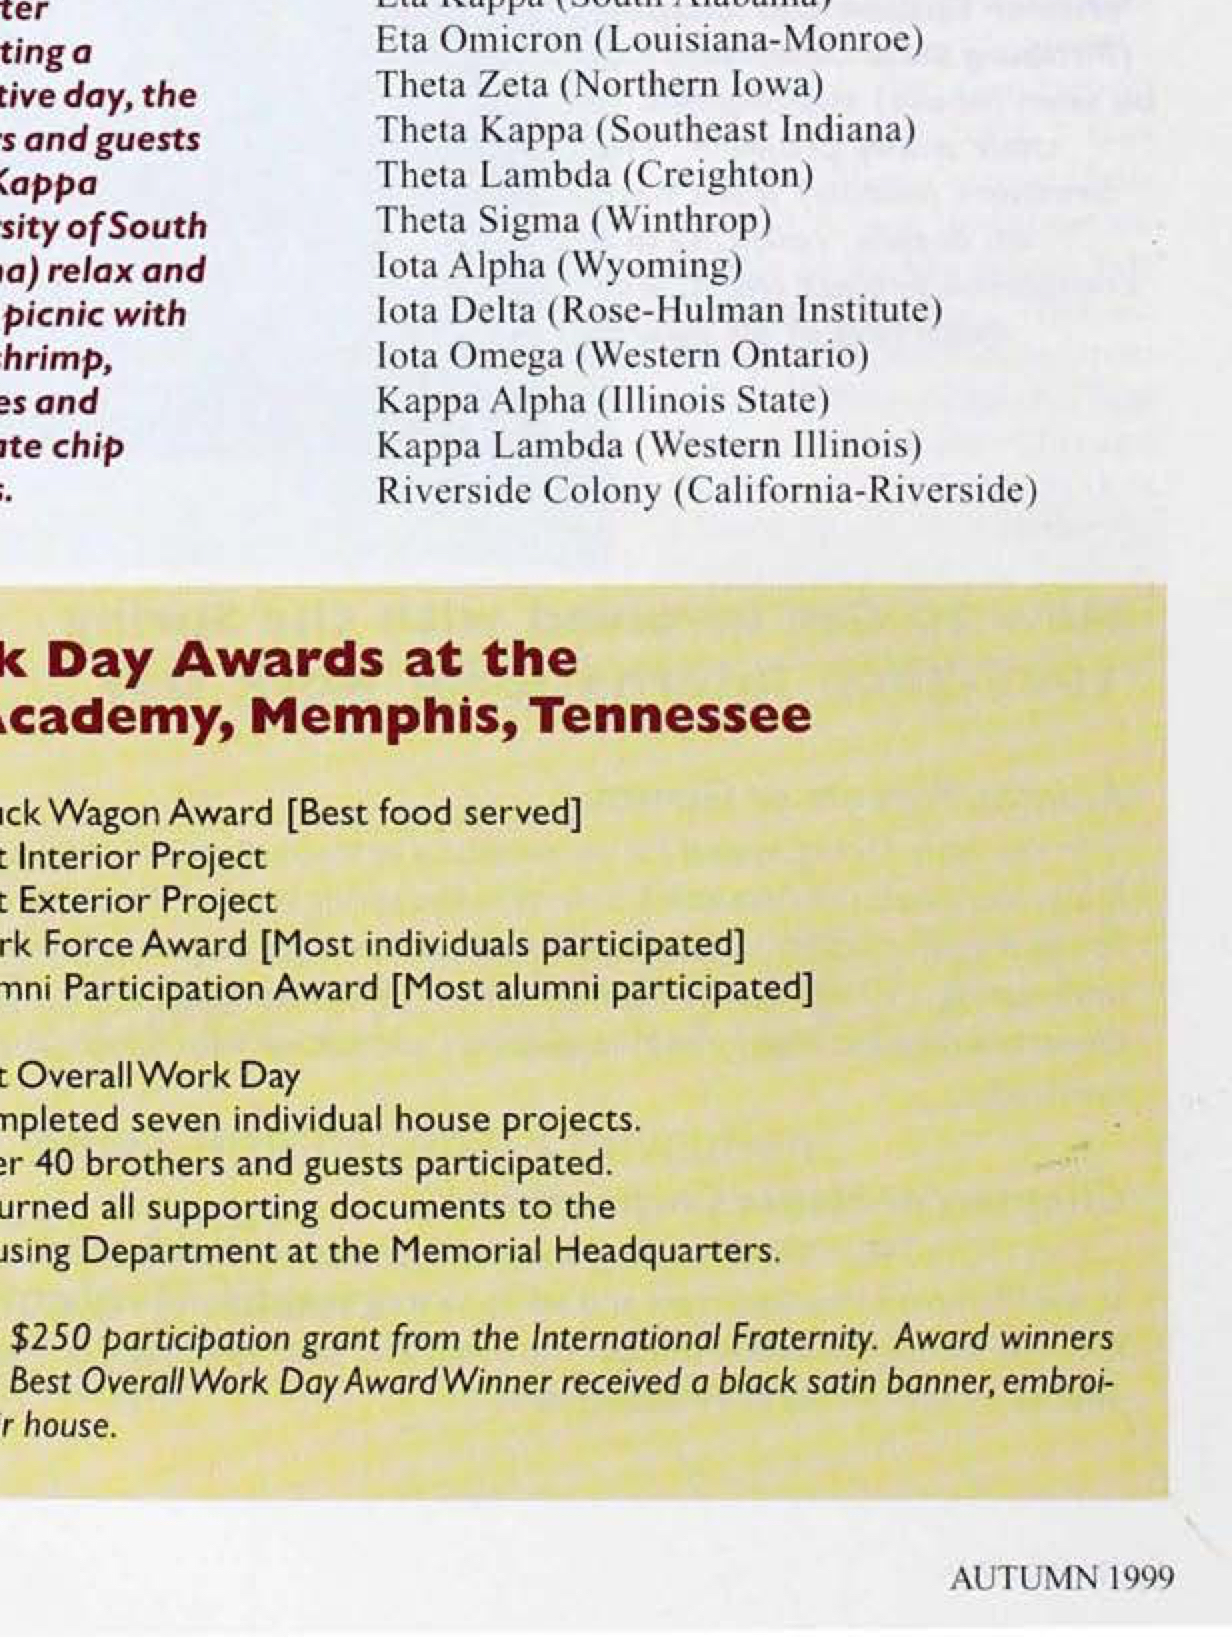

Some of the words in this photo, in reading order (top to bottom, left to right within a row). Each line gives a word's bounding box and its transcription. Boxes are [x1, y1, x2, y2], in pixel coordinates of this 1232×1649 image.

[71, 44, 93, 64] a
[377, 24, 428, 54] Eta
[440, 24, 582, 53] Omicron
[595, 24, 923, 56] (Louisiana-Monroe)
[63, 79, 133, 118] day,
[141, 79, 197, 108] the
[23, 122, 89, 152] and
[94, 128, 201, 161] guests
[67, 210, 108, 248] of
[108, 210, 207, 240] South
[378, 386, 479, 422] Kappa
[491, 384, 586, 422] Alpha
[597, 384, 725, 418] (Illinois
[737, 384, 829, 416] State)
[378, 474, 531, 504] Riverside
[543, 474, 661, 512] Colony
[674, 474, 1037, 507] (California-Riverside)
[47, 640, 155, 690] Day
[171, 639, 385, 678] Awards
[405, 639, 463, 678] at
[481, 638, 577, 678] the
[251, 694, 518, 746] Memphis,
[529, 696, 812, 734] Tennessee
[47, 796, 161, 836] Wagon
[168, 796, 273, 826] Award
[287, 796, 369, 834] [Best
[379, 796, 451, 826] food
[464, 796, 581, 834] served]
[19, 884, 152, 914] Exterior
[163, 884, 277, 922] Project
[83, 1234, 277, 1273] Department
[287, 1242, 319, 1264] at
[329, 1234, 380, 1264] the
[392, 1234, 541, 1264] Memorial
[555, 1234, 781, 1272] Headquarters.
[10, 1321, 91, 1354] $250
[103, 1324, 291, 1360] participation
[301, 1328, 381, 1360] grant
[391, 1322, 460, 1358] from
[473, 1322, 519, 1352] the
[531, 1322, 721, 1352] International
[732, 1320, 878, 1360] Fraternity.
[893, 1321, 990, 1352] Award
[1000, 1323, 1115, 1351] winners
[951, 1564, 1097, 1590] AUTUMN
[1111, 1564, 1175, 1590] 1999
